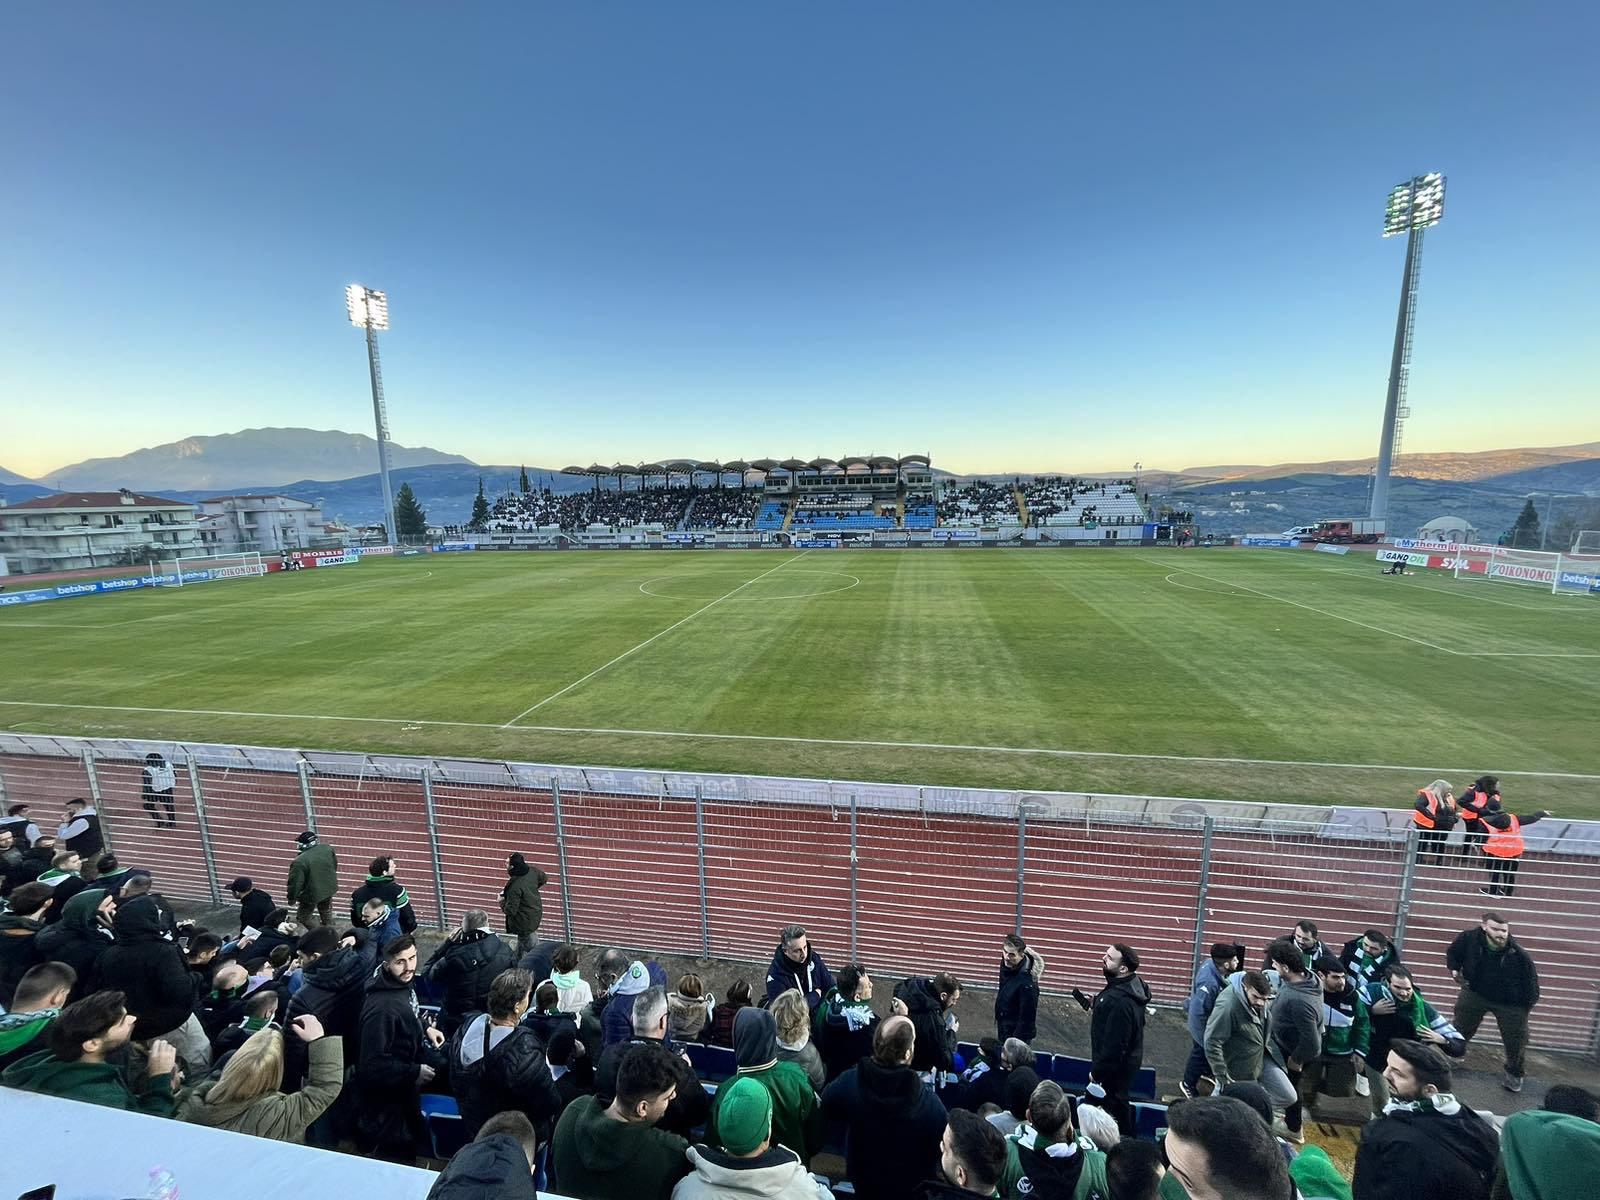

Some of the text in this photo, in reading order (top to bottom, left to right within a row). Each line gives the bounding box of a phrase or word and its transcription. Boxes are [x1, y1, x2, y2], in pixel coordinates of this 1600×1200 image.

[1386, 552, 1425, 564] GAND OIL
[102, 578, 138, 588] betshop
[57, 584, 97, 594] betshop
